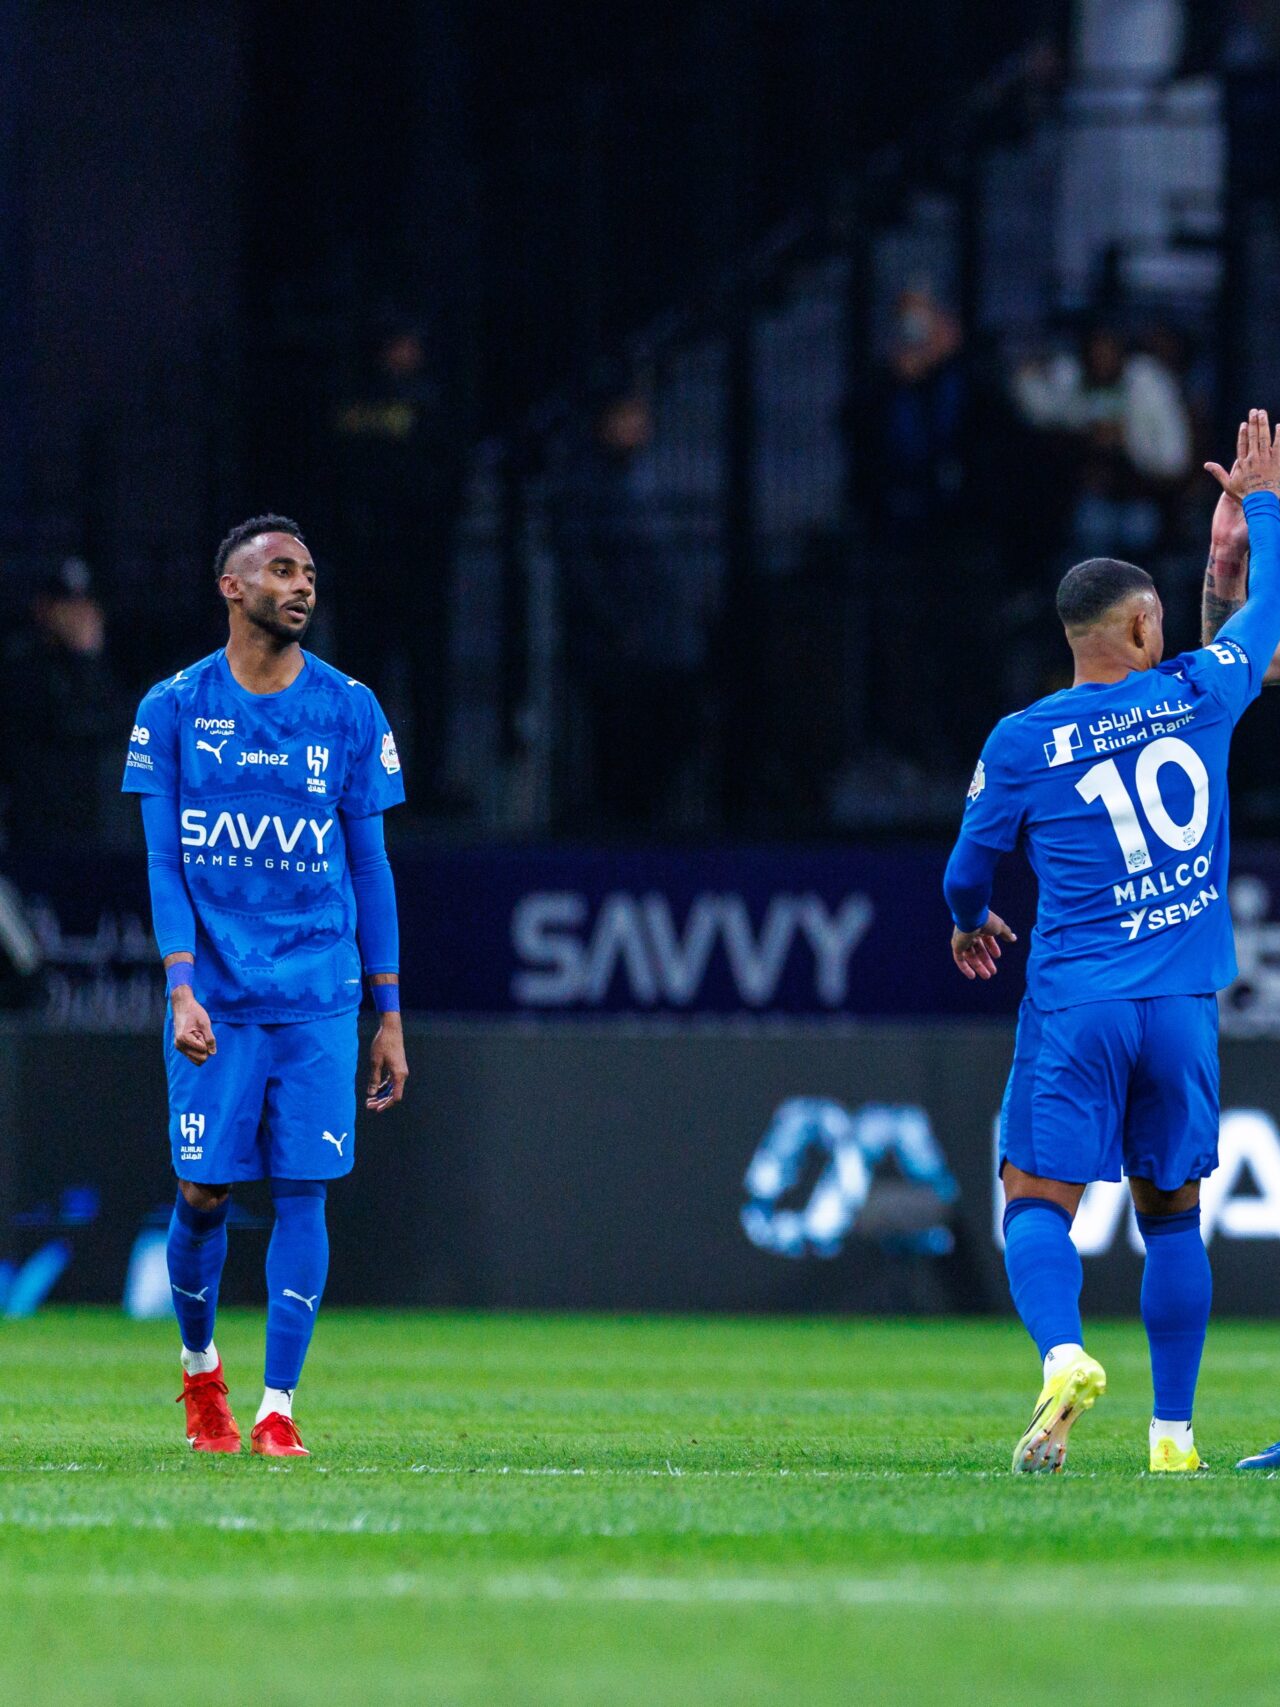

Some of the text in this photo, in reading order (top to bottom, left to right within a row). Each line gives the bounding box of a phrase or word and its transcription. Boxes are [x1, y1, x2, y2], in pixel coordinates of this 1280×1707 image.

[195, 718, 235, 730] flynas
[1089, 707, 1142, 735] الرياض
[1151, 713, 1195, 736] Bank
[1074, 736, 1209, 874] 10
[181, 809, 333, 855] SAVVY
[183, 852, 329, 873] GAMES GROUP
[511, 893, 872, 1004] SAVVY
